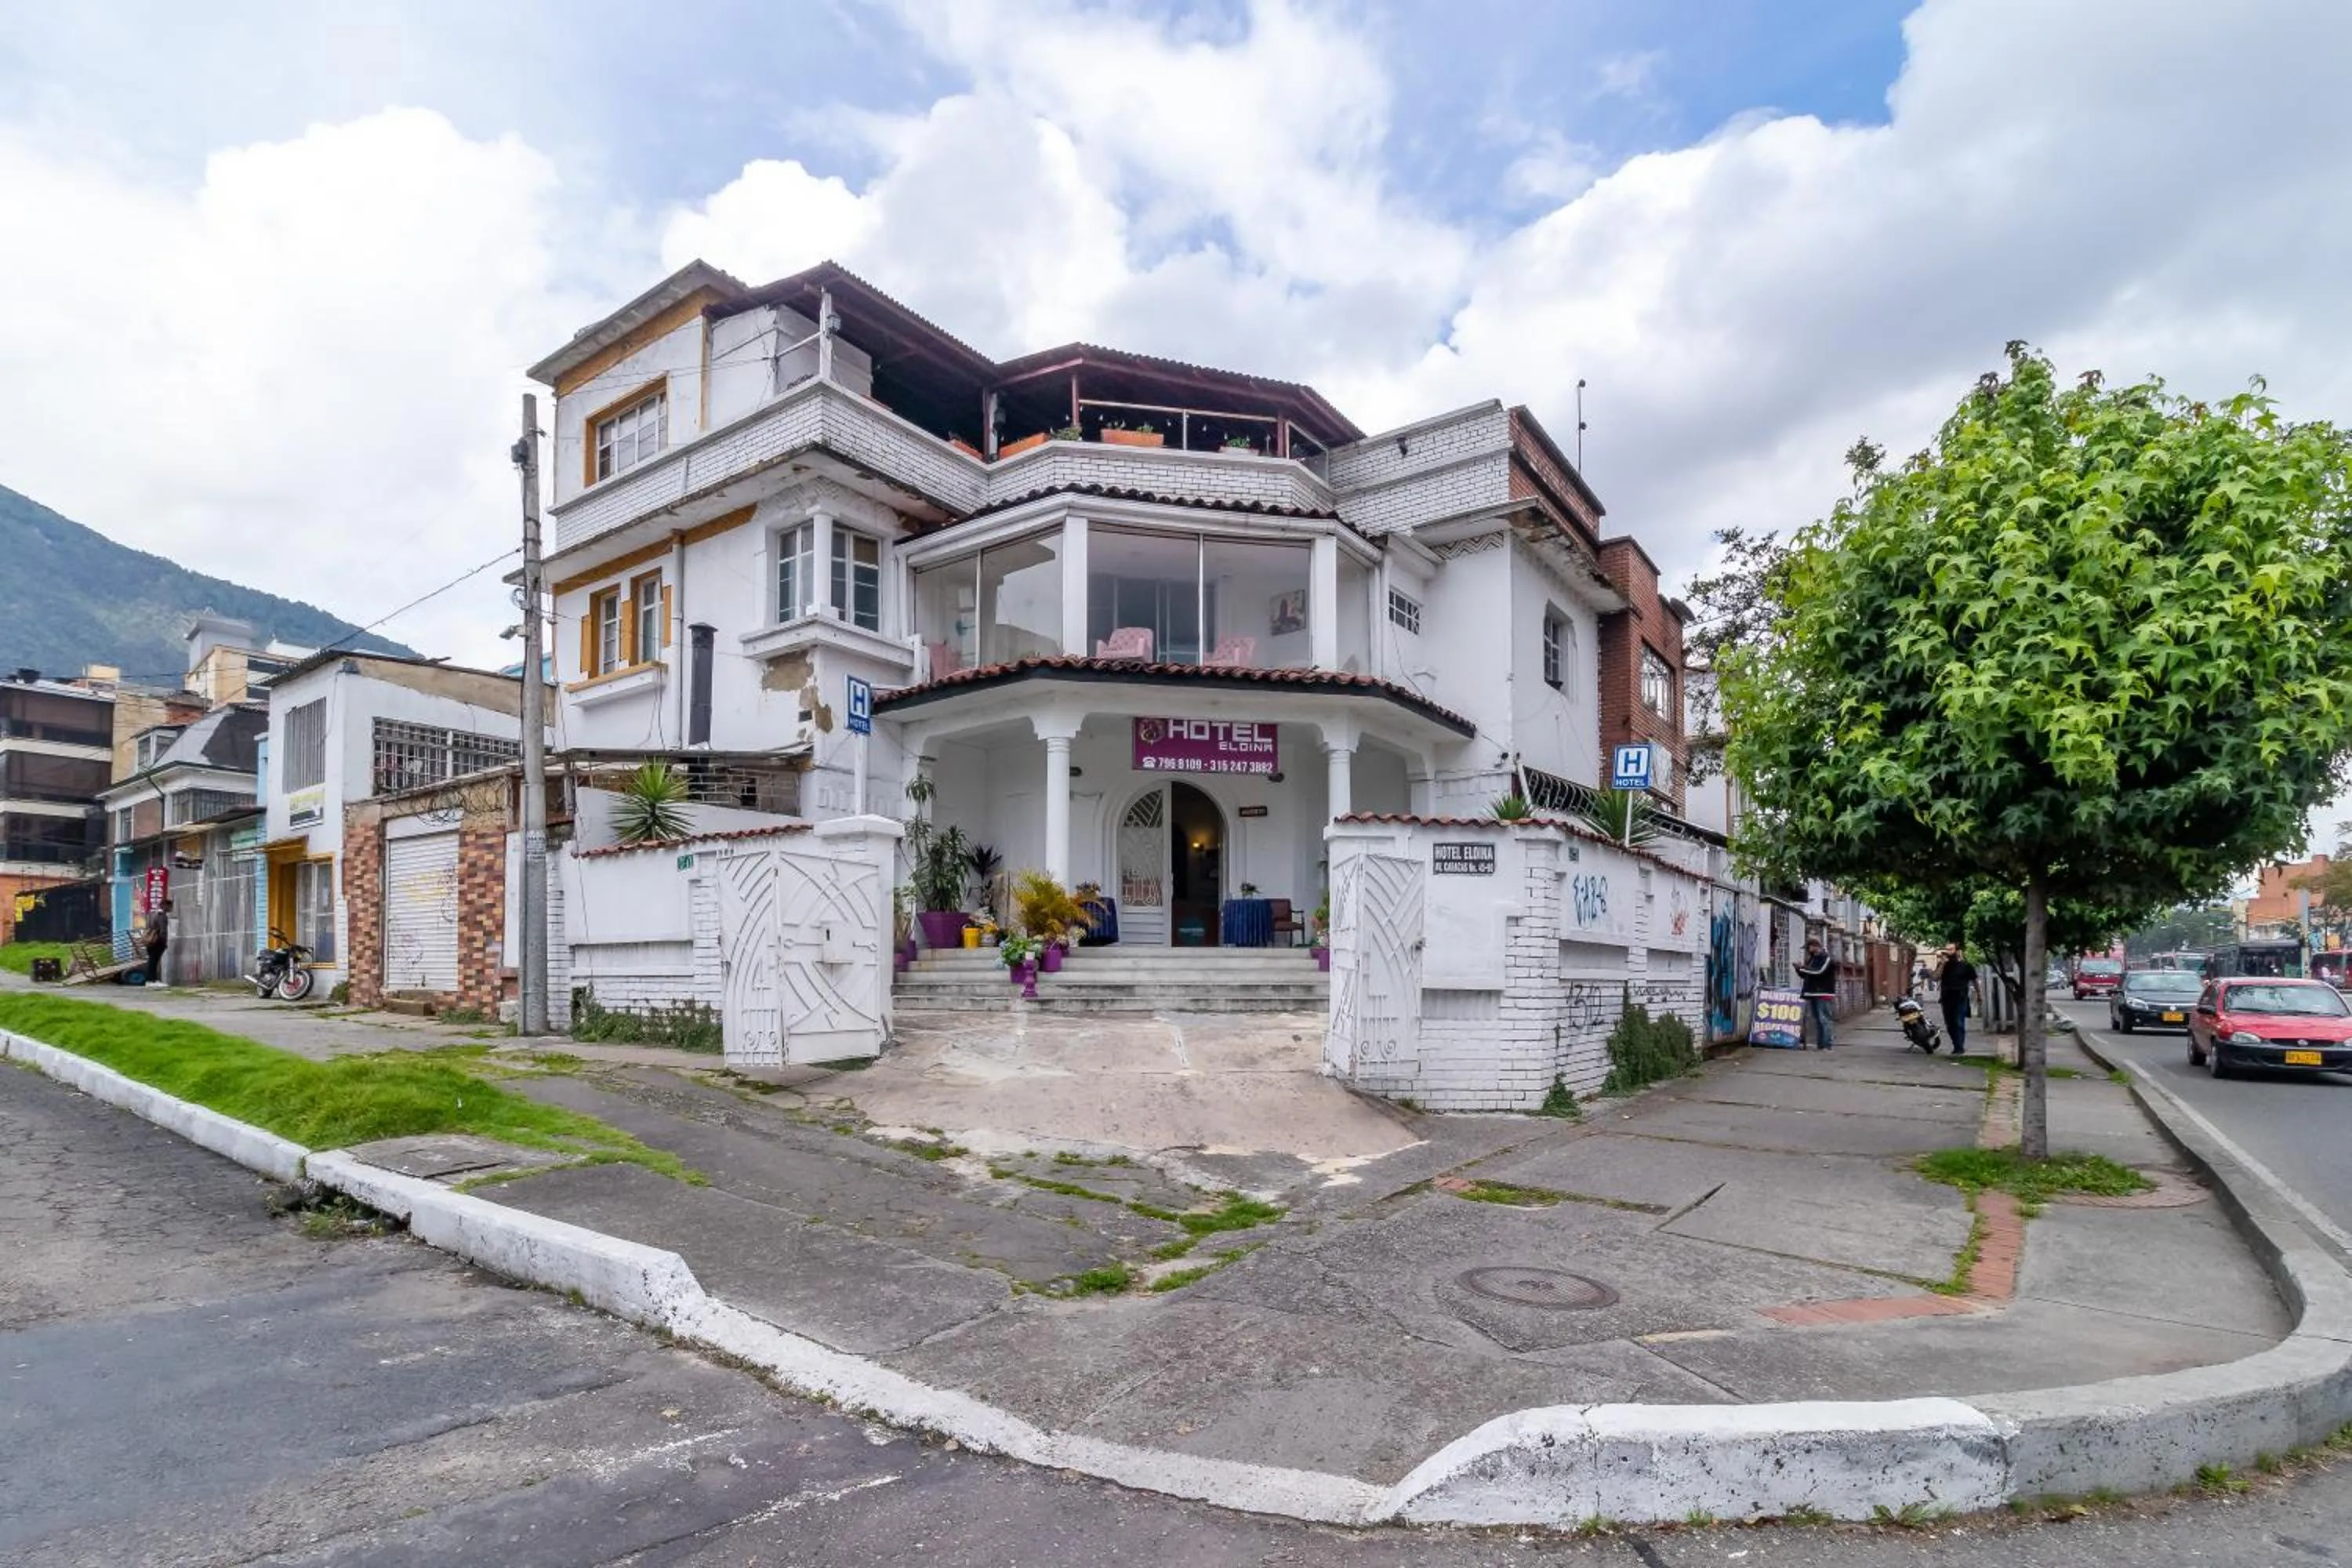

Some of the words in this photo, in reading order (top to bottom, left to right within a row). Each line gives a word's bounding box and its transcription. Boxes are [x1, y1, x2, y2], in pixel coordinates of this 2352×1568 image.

[853, 684, 866, 716] H
[1167, 719, 1272, 742] HOTEL
[1219, 741, 1272, 753] ELOINA
[1230, 760, 1247, 772] 247
[1624, 750, 1642, 774] H
[1435, 846, 1461, 860] HOTEL
[1757, 1002, 1802, 1022] $100
